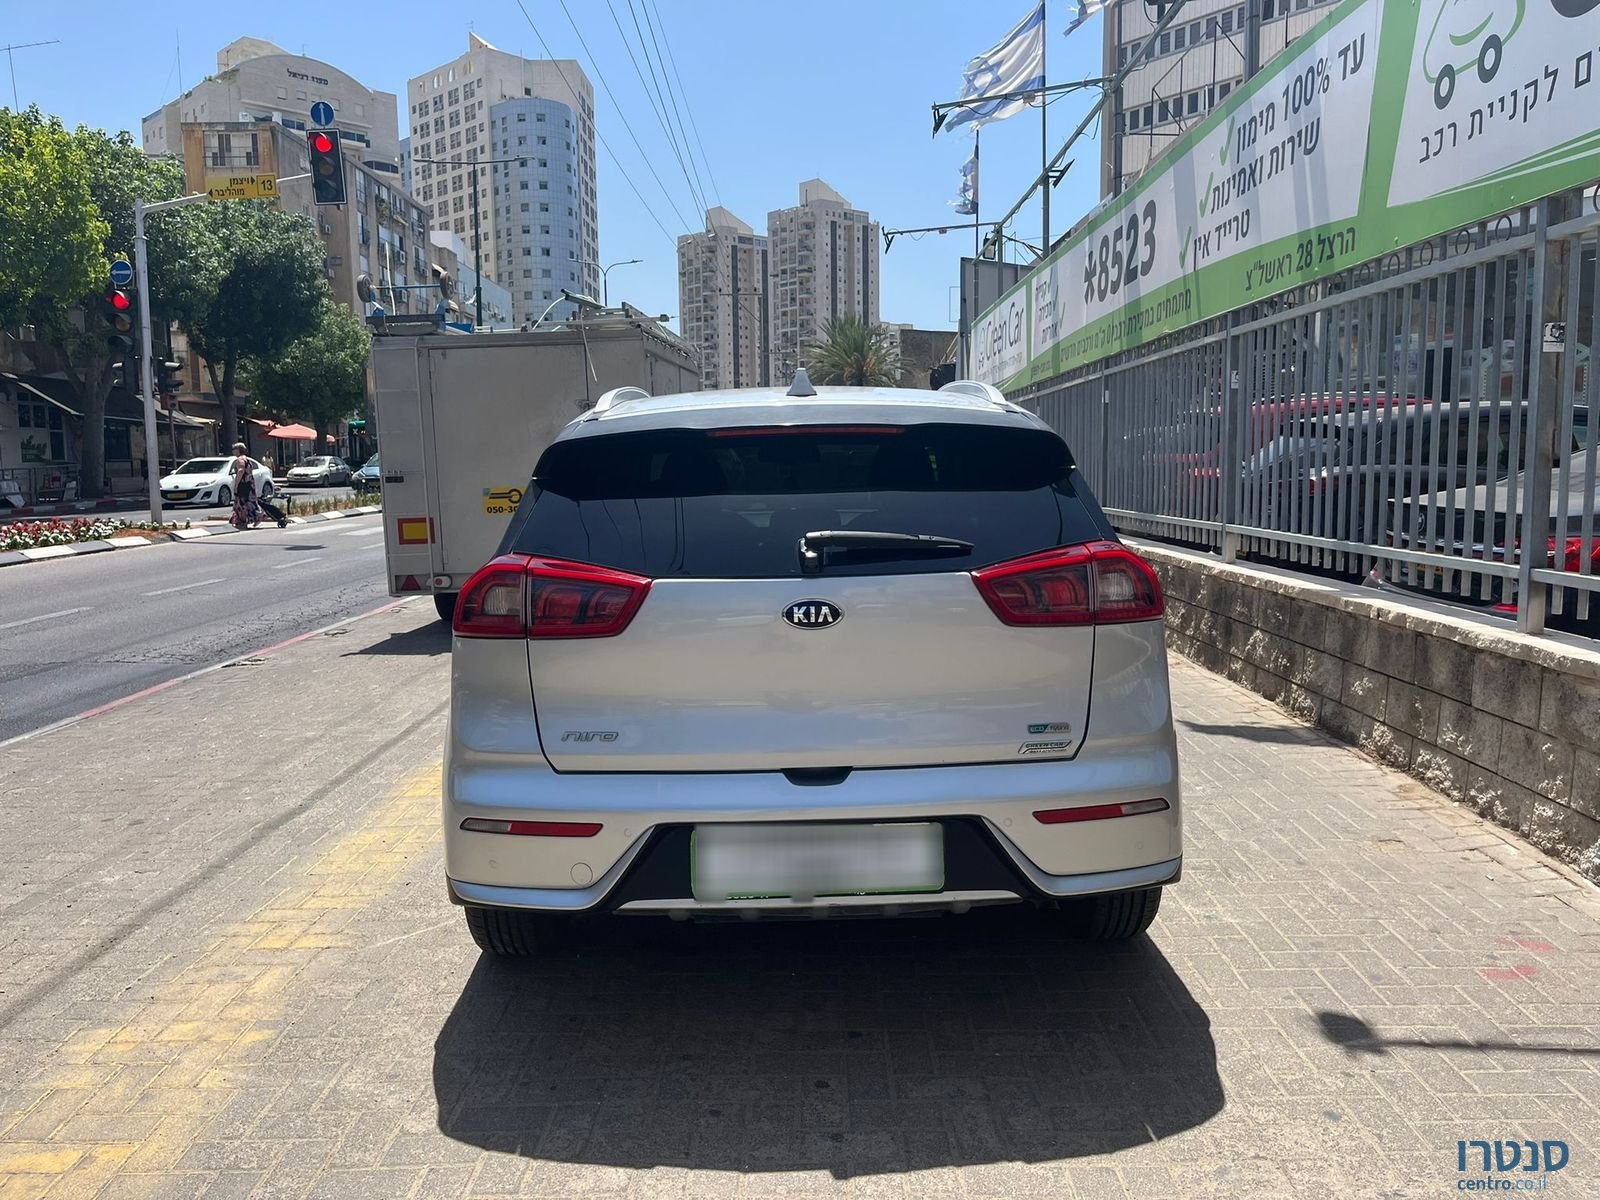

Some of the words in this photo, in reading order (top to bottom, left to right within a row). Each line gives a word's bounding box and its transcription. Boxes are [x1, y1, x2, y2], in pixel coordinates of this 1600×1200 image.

[1338, 33, 1366, 81] עד
[1282, 57, 1330, 121] 100%
[1468, 64, 1559, 140] לקניית
[1236, 102, 1275, 164] מימון
[1267, 117, 1320, 180] שירות
[1419, 122, 1457, 163] רכב
[229, 177, 249, 187] ויצמן
[261, 179, 273, 191] 13
[1211, 155, 1264, 214] ואמינות
[1215, 208, 1250, 252] טרייד
[1317, 226, 1356, 263] הרצל
[1193, 231, 1211, 272] אין
[1296, 240, 1313, 272] 28
[1156, 288, 1191, 322] מתמחים
[793, 606, 833, 623] KIA
